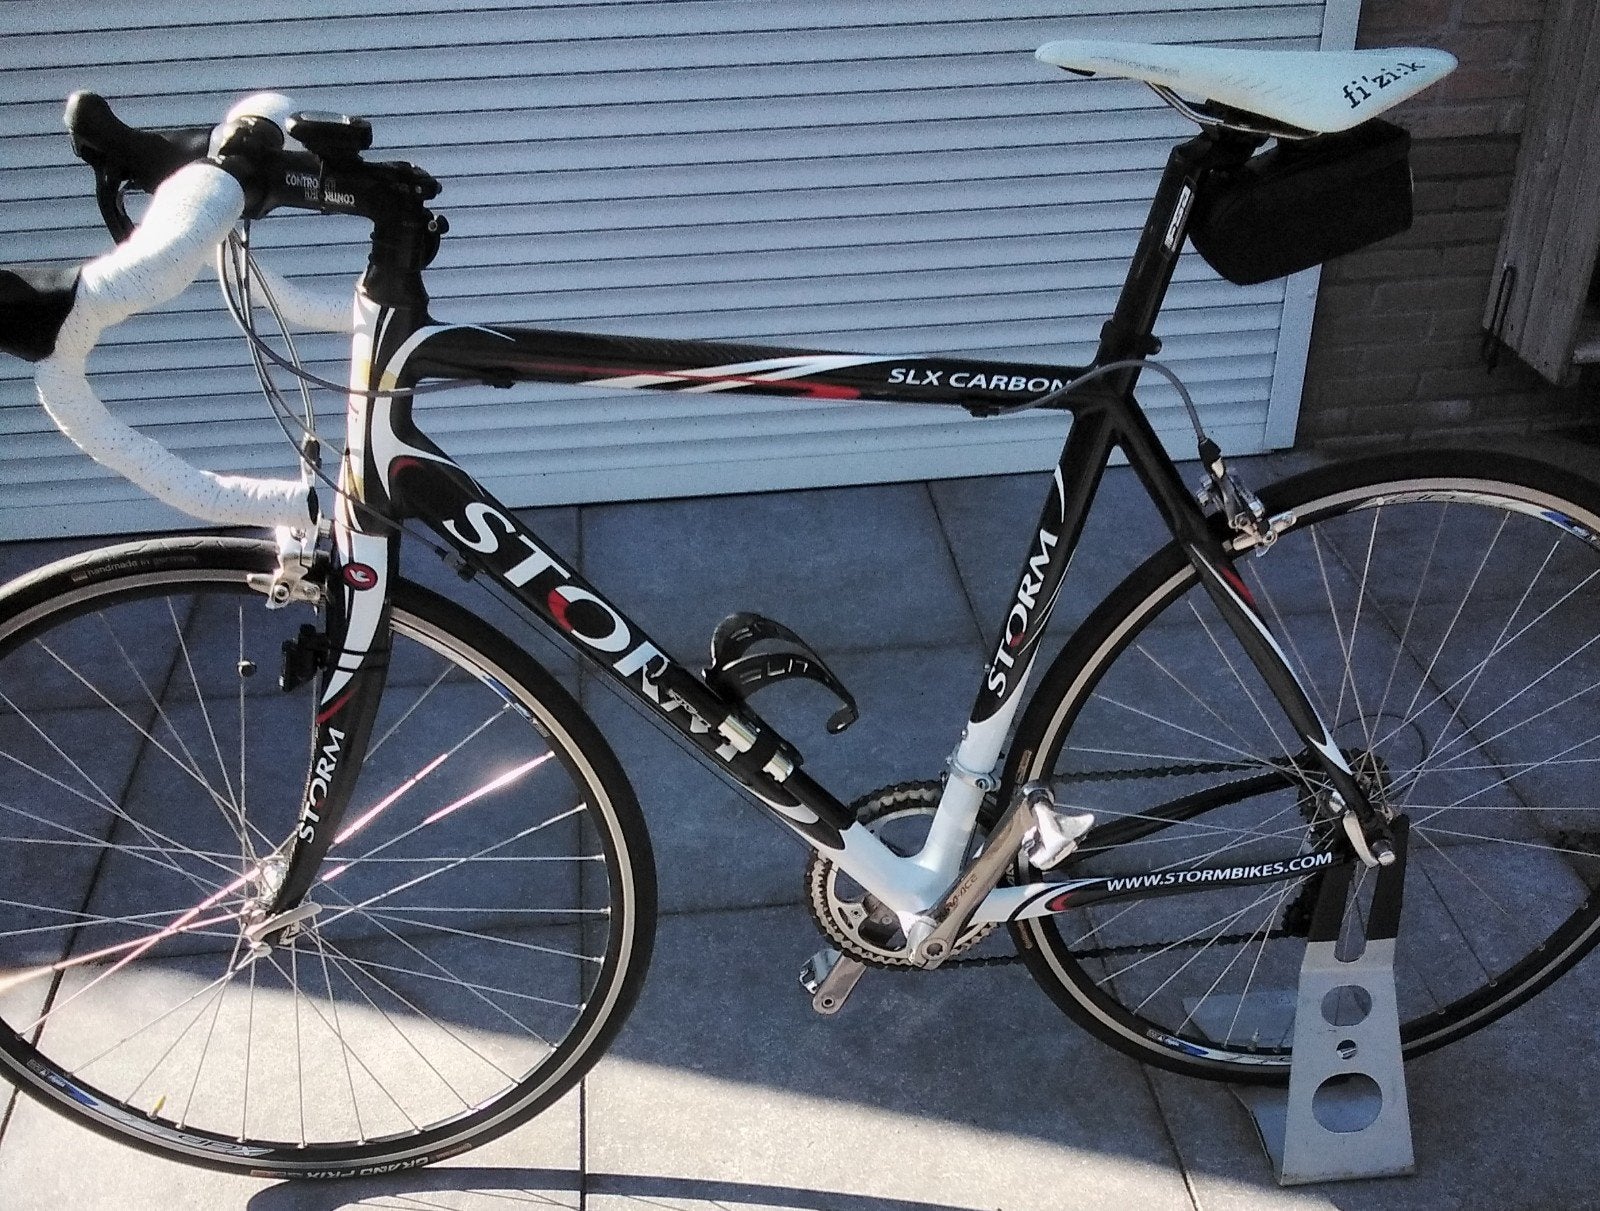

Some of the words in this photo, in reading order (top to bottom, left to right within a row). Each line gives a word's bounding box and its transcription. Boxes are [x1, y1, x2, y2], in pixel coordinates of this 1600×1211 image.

[285, 172, 320, 189] CONTRO
[887, 367, 944, 387] SLX
[949, 372, 1072, 393] CARBON
[987, 527, 1059, 699] STORM
[298, 726, 346, 845] STORM
[1106, 851, 1333, 892] WWW.STORMBIKES.COM
[359, 1156, 430, 1176] GRAND
